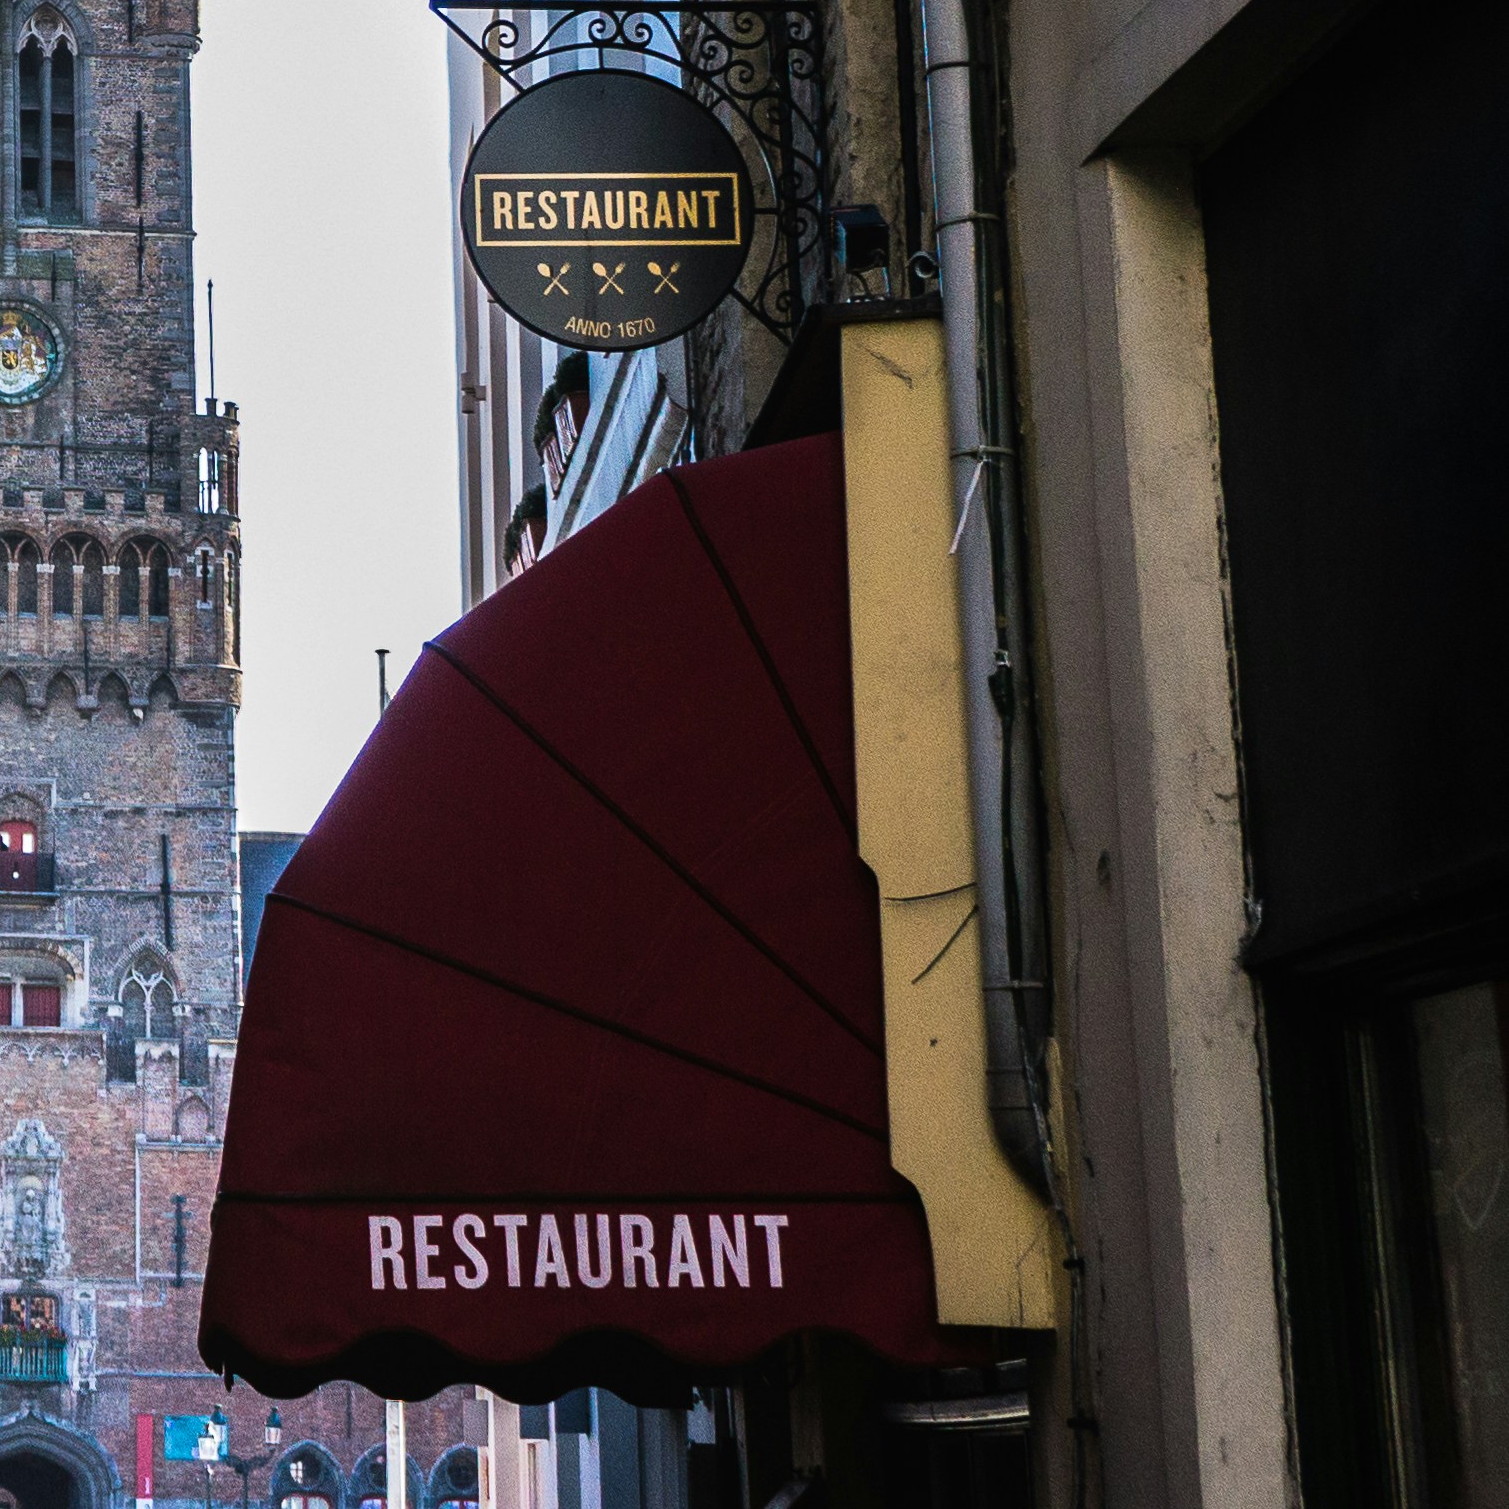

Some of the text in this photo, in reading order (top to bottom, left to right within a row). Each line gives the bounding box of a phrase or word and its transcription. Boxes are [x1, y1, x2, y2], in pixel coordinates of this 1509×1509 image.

[492, 190, 721, 230] RESTAURANT
[564, 316, 656, 339] ANNO 1670
[367, 1213, 790, 1290] RESTAURANT
